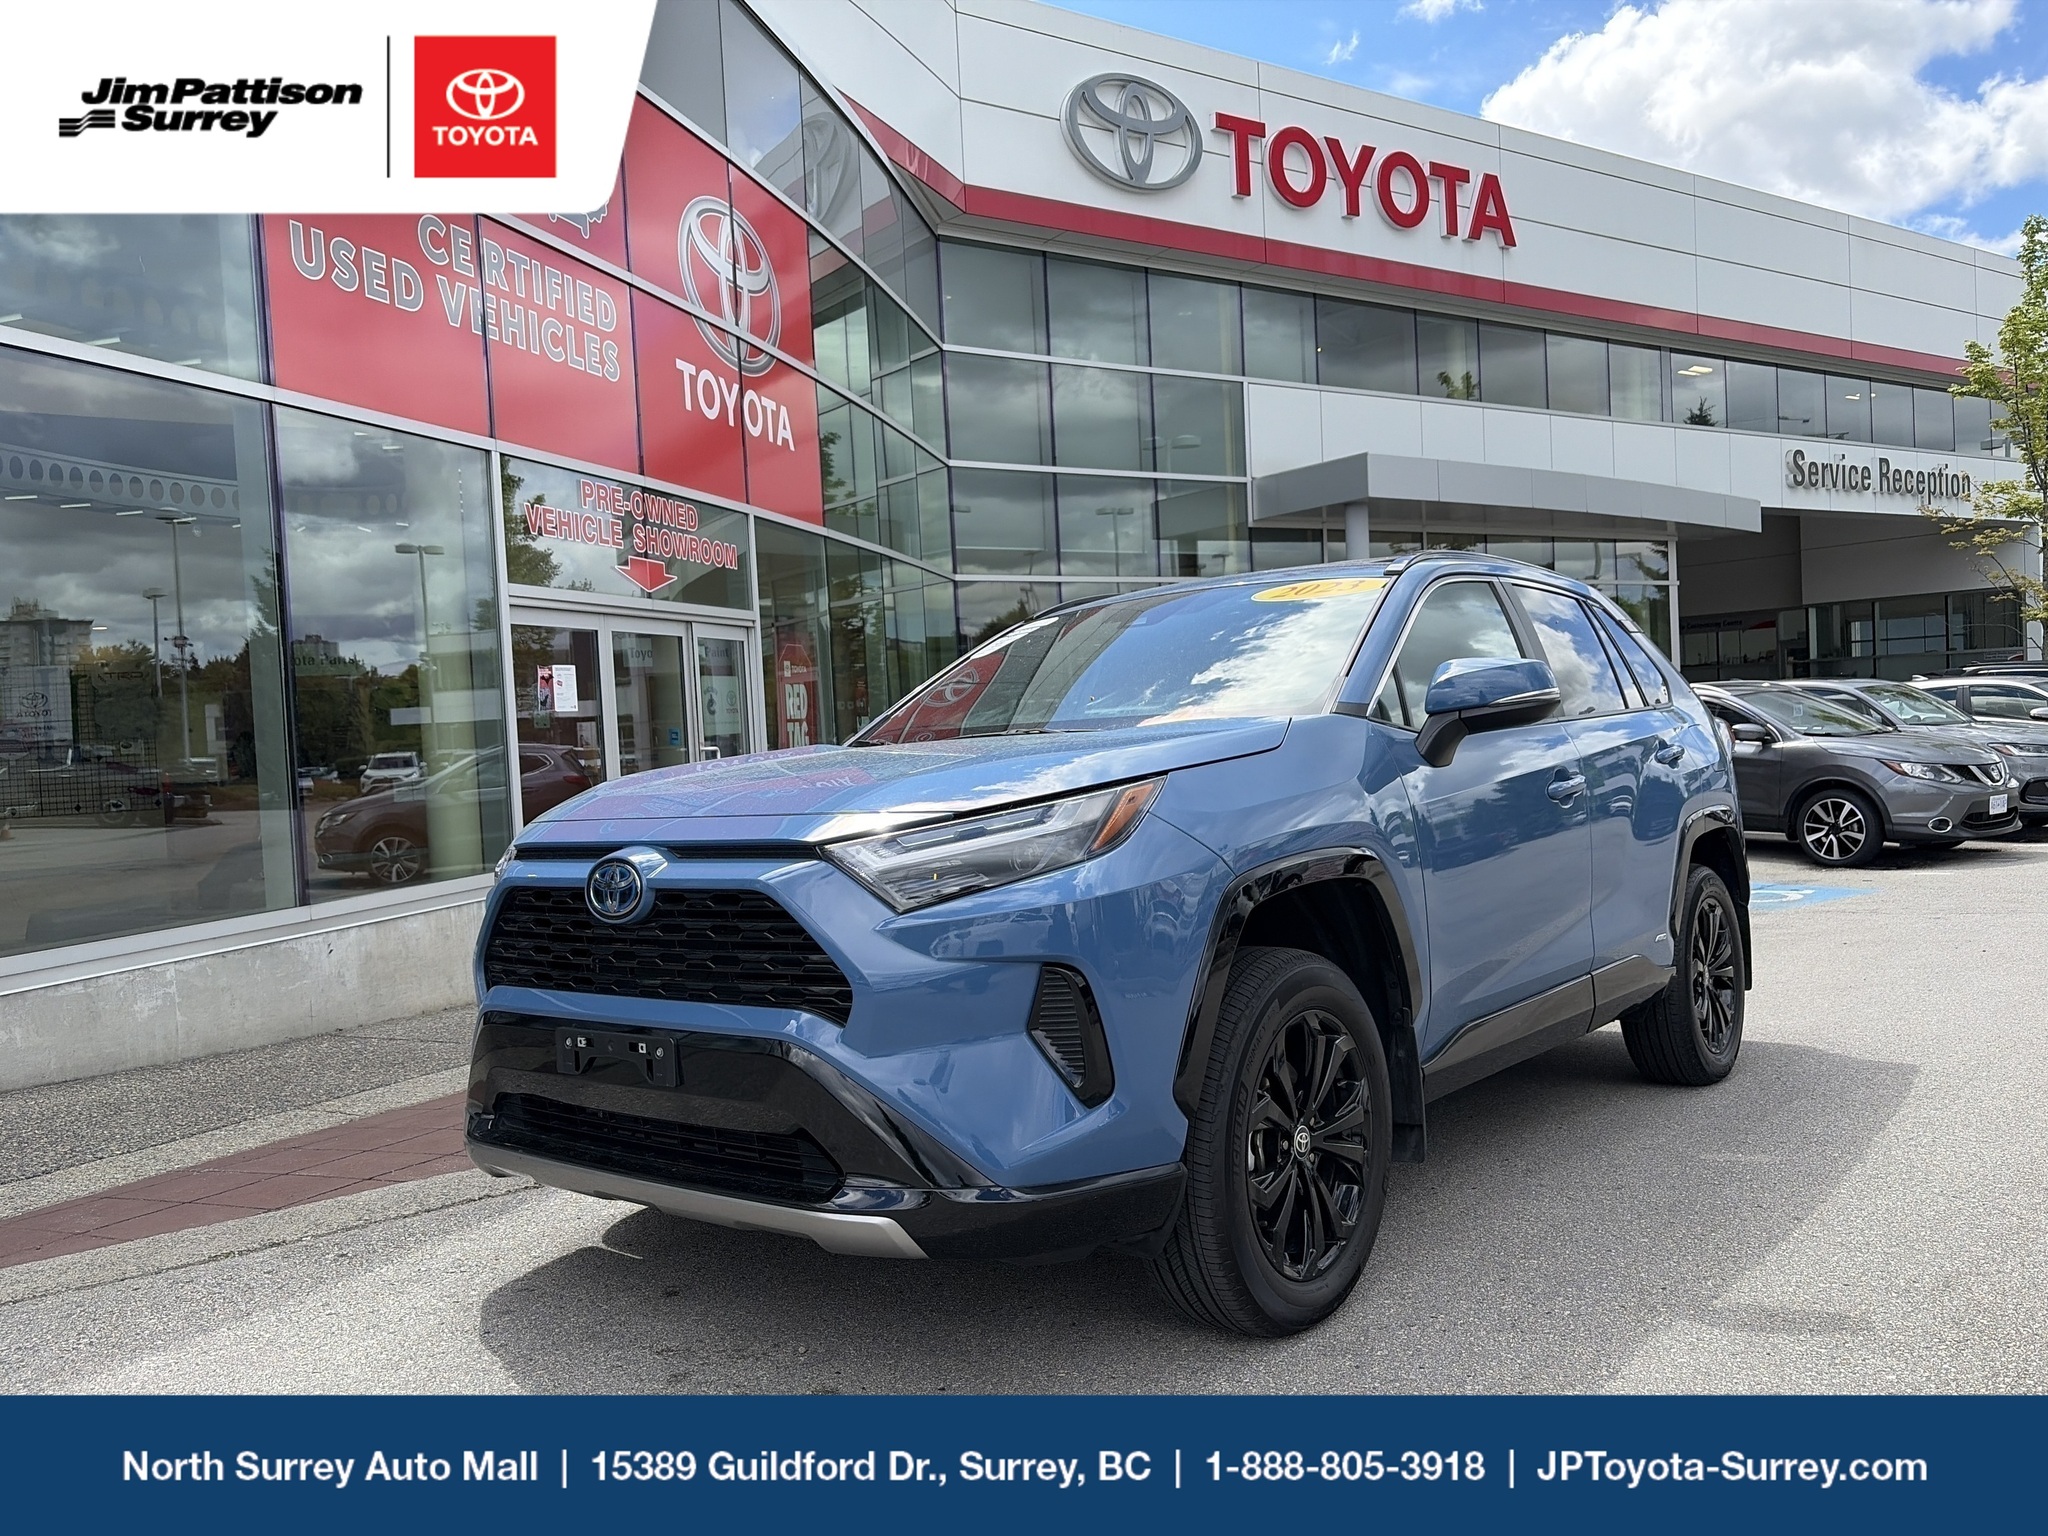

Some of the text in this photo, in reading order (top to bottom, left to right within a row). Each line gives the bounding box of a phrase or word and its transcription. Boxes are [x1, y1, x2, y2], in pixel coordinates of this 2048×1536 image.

[1211, 111, 1517, 249] TOYOTA
[289, 219, 621, 382] USED VEHICLES
[417, 213, 617, 332] CERTIFIED
[675, 357, 795, 452] TOYOTA
[580, 479, 699, 532] PRE-OWNED
[1790, 449, 1971, 505] Service Reception
[524, 503, 738, 570] VEHICLE SHOWROOM
[785, 683, 808, 720] RED
[787, 721, 810, 747] TAG
